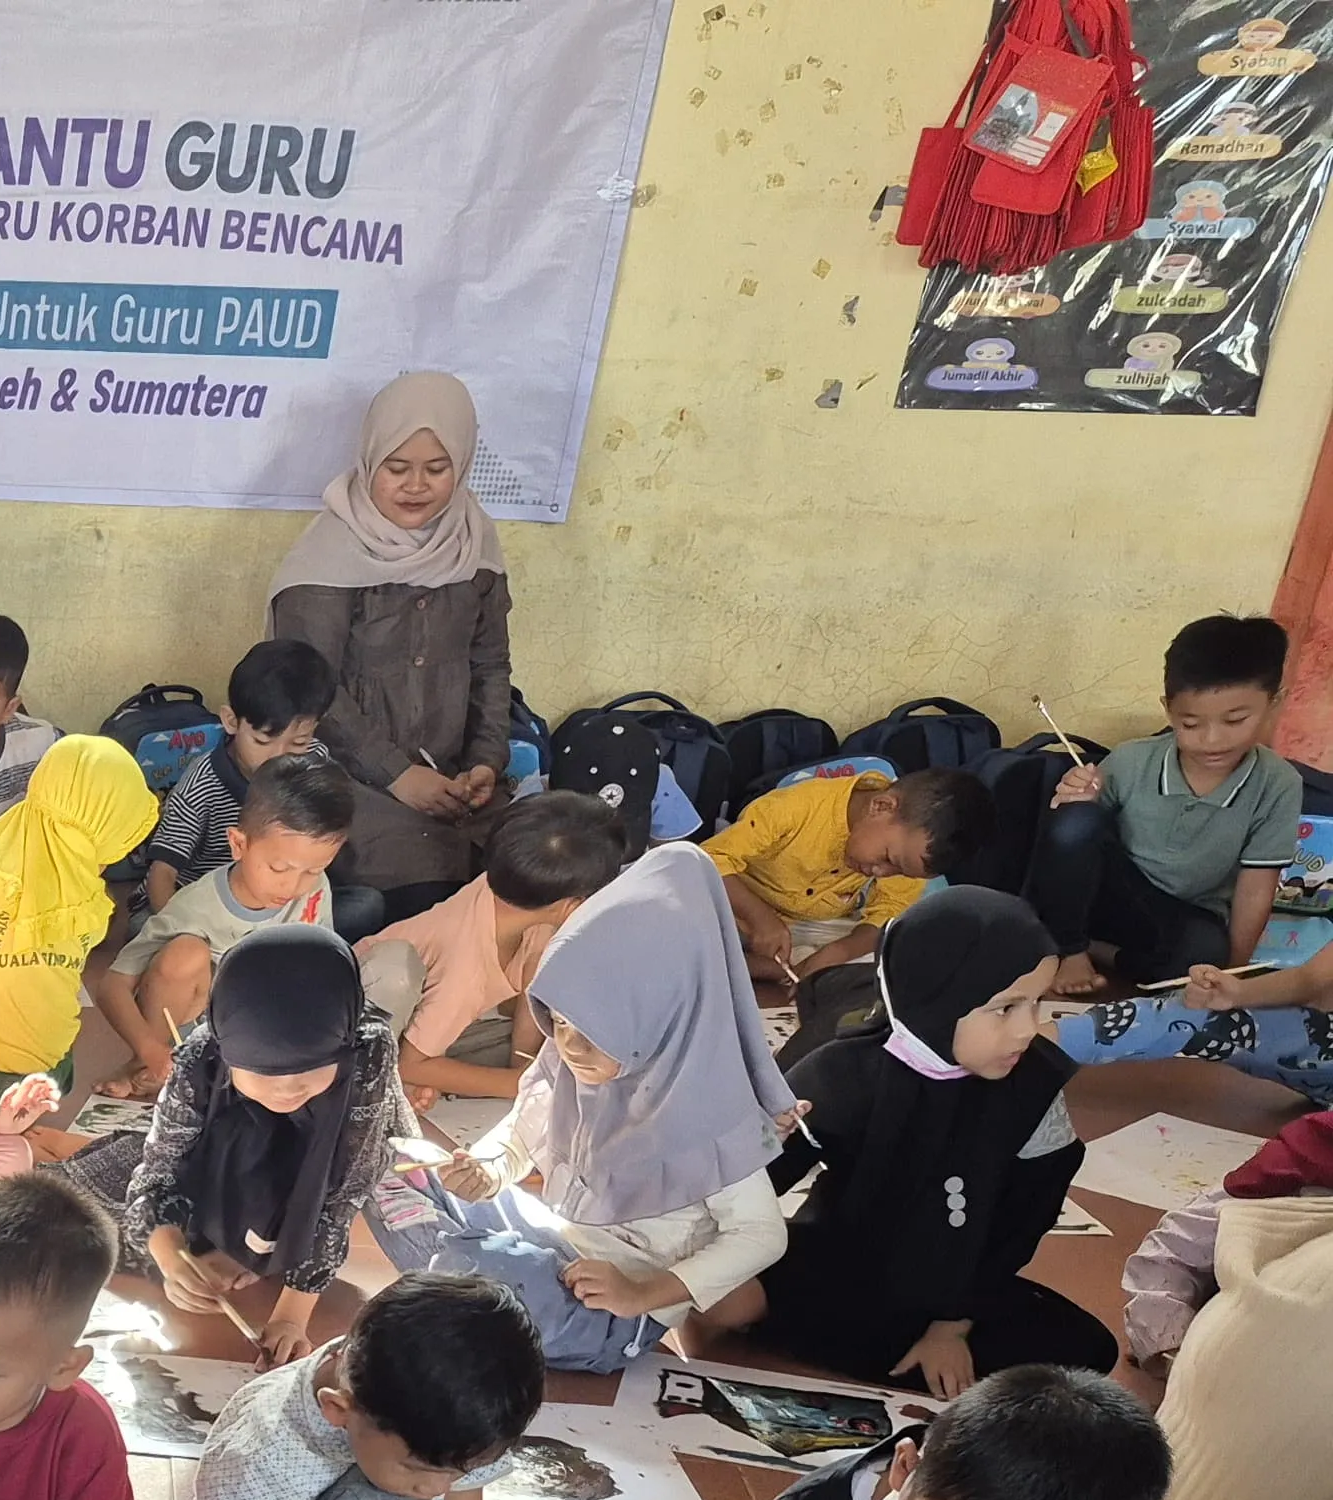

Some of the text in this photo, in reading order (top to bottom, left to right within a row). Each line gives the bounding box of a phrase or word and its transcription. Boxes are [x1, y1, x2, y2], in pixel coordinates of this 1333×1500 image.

[1230, 55, 1287, 71] Syaban
[1180, 139, 1264, 155] Ramadhan
[165, 120, 355, 200] GURU
[49, 201, 211, 249] KORBAN
[220, 209, 404, 265] BENCANA
[1167, 221, 1222, 236] Syawal
[110, 294, 205, 346] Guru
[215, 297, 322, 349] PAUD
[942, 370, 1024, 382] Jumadil Akhir
[49, 368, 79, 413] &
[89, 369, 268, 418] Sumatera
[168, 729, 206, 752] Ayo
[1294, 848, 1324, 872] UD
